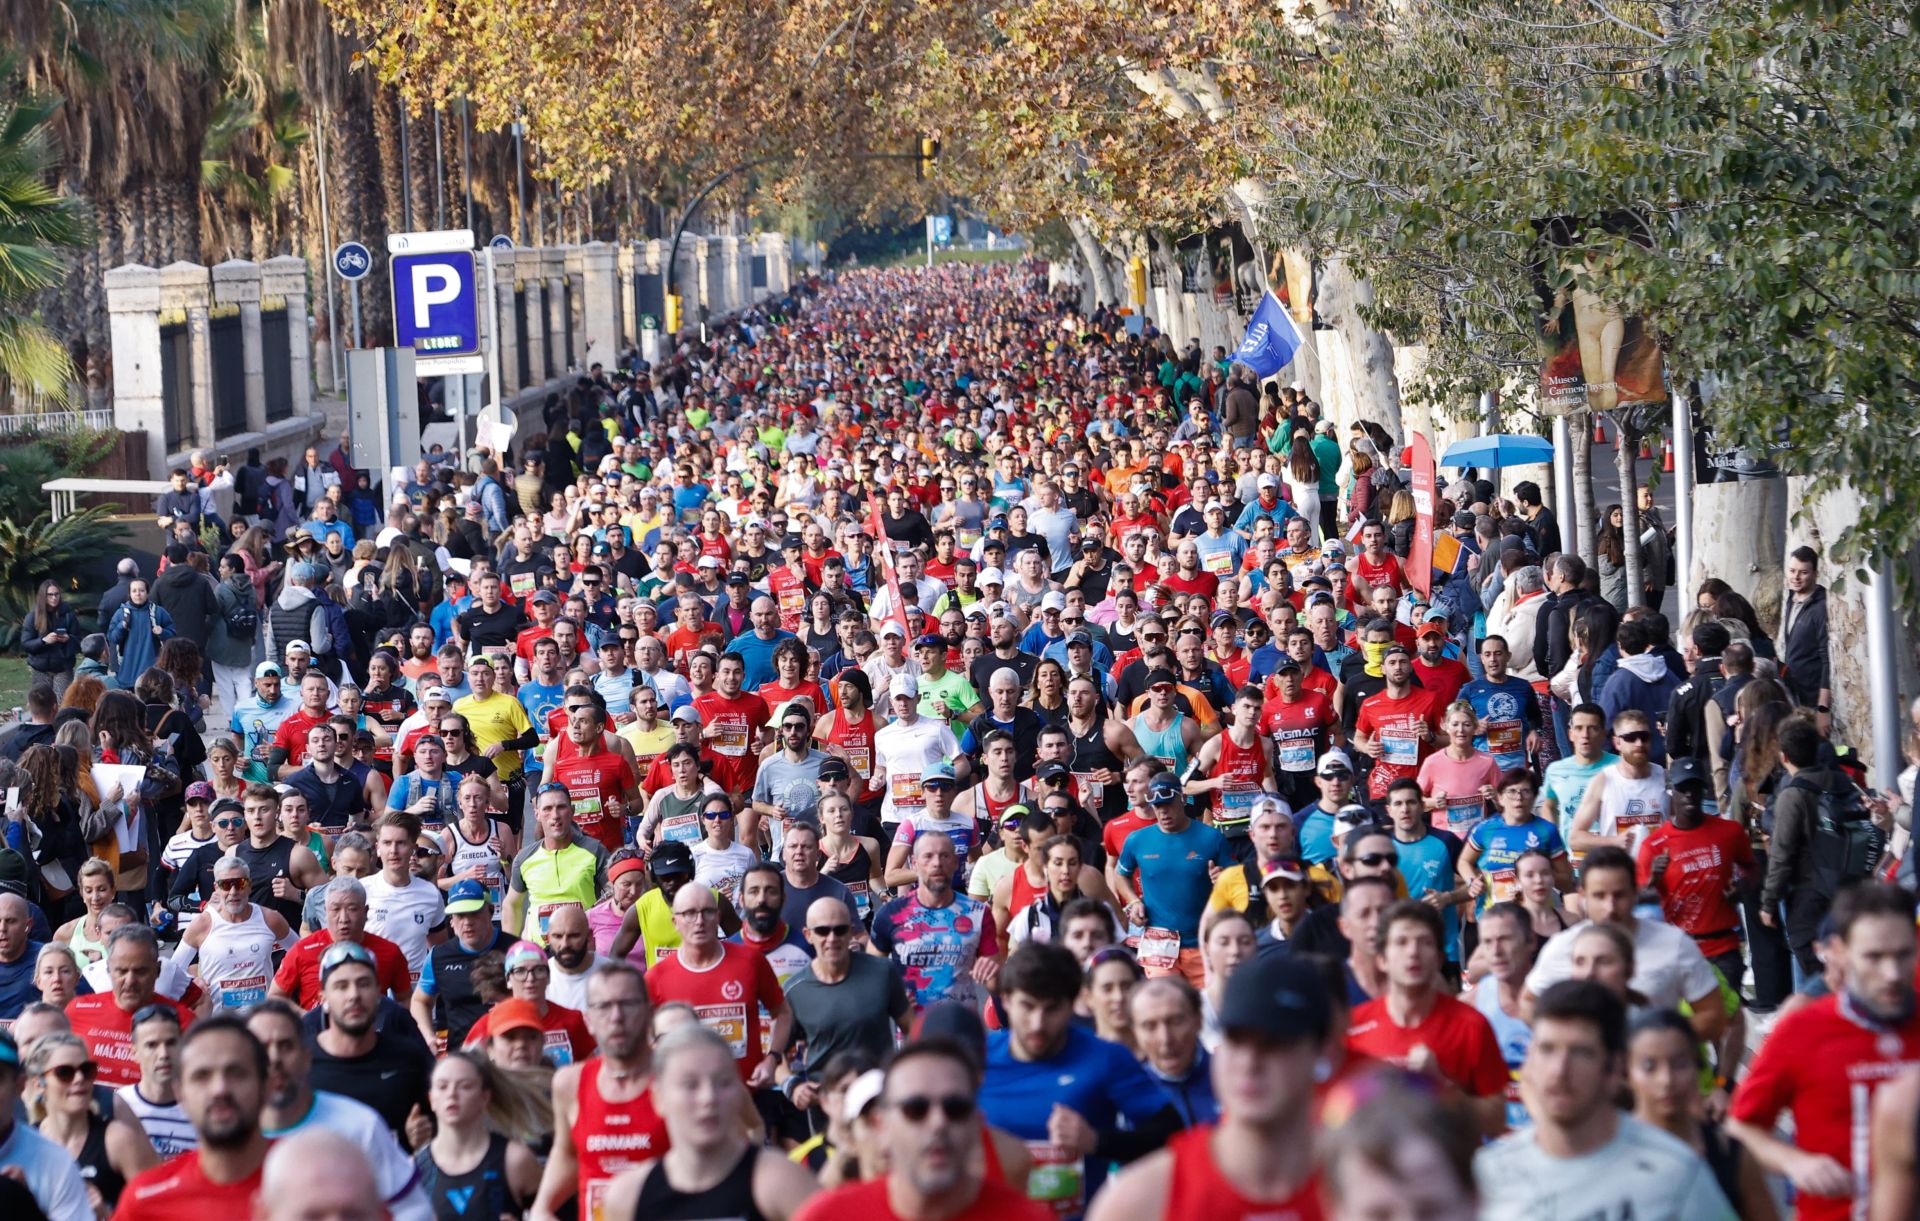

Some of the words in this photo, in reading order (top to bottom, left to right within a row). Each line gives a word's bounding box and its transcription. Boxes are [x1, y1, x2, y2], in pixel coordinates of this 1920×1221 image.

[411, 263, 462, 329] P
[1548, 376, 1578, 385] Museo
[1549, 386, 1584, 396] Carmen
[1583, 382, 1618, 392] Thyssen
[1706, 456, 1747, 469] Málaga
[461, 852, 488, 860] REBECCA
[586, 1134, 651, 1152] DENMARK
